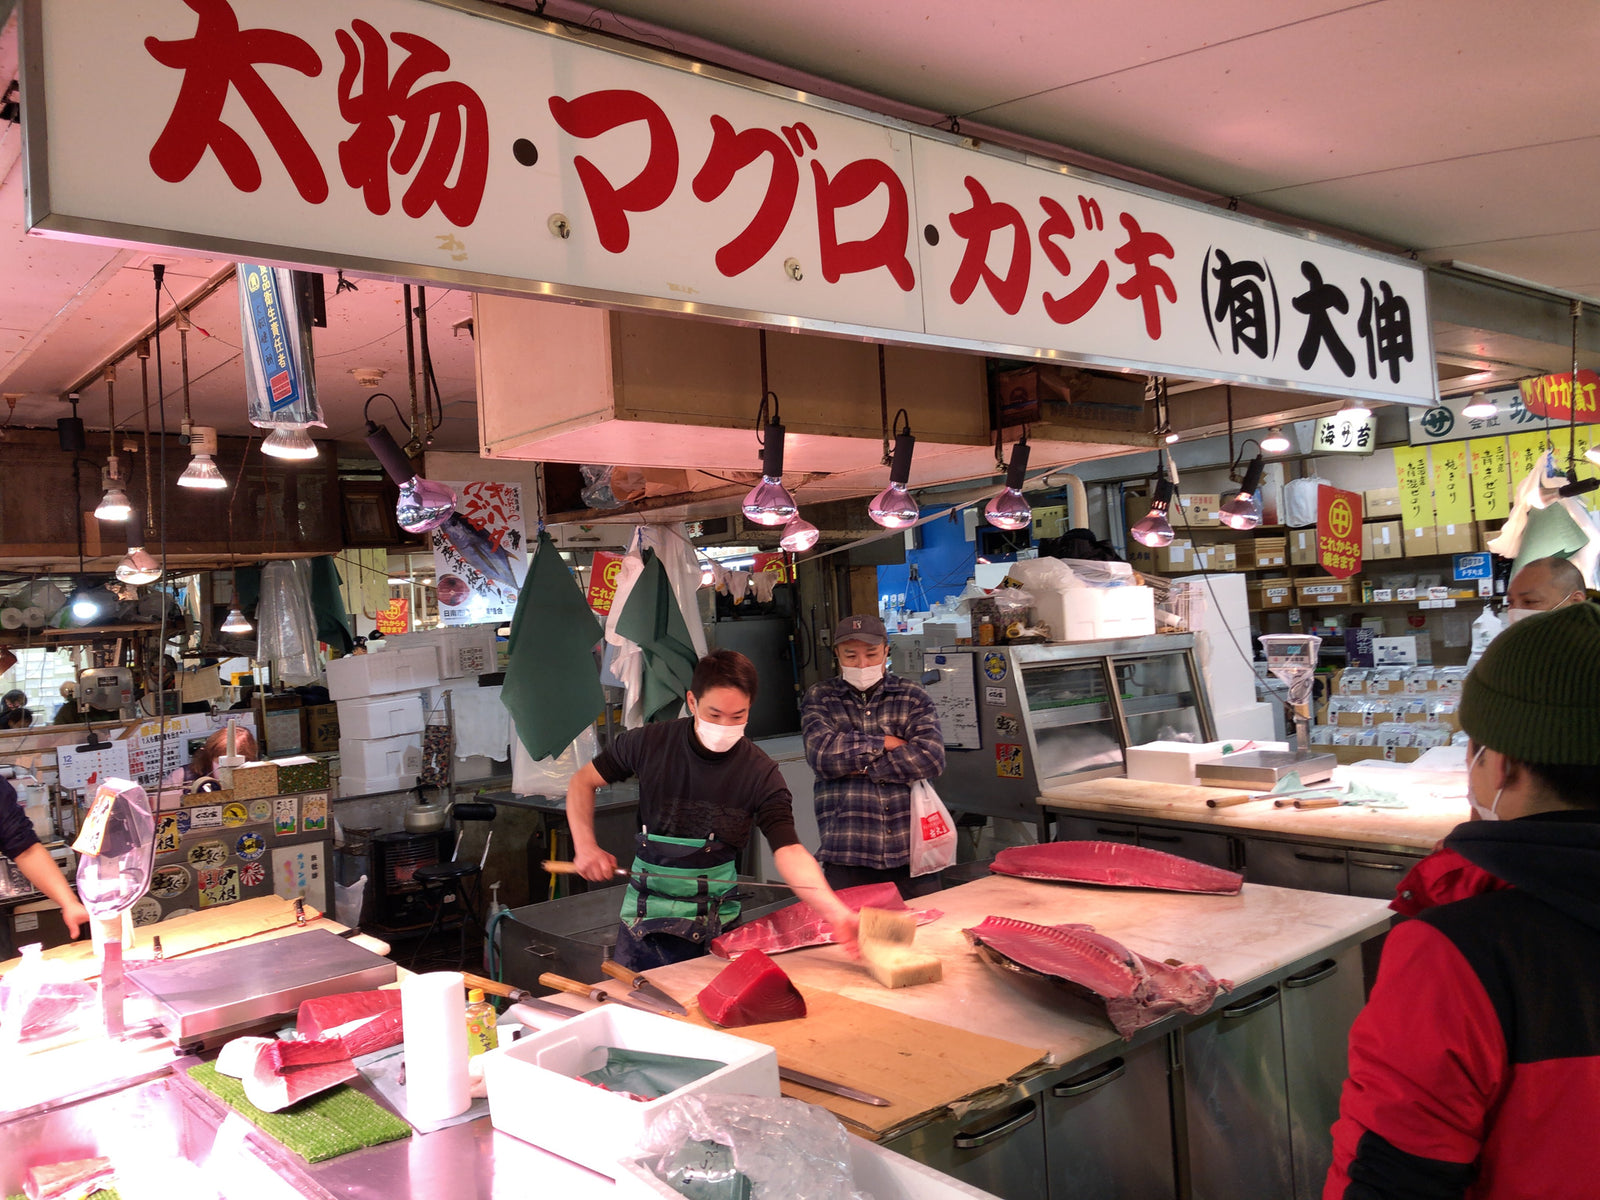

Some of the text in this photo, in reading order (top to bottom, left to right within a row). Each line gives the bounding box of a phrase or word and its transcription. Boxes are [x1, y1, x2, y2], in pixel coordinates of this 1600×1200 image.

[1320, 536, 1361, 557] これからも
[1323, 551, 1356, 571] 続きます
